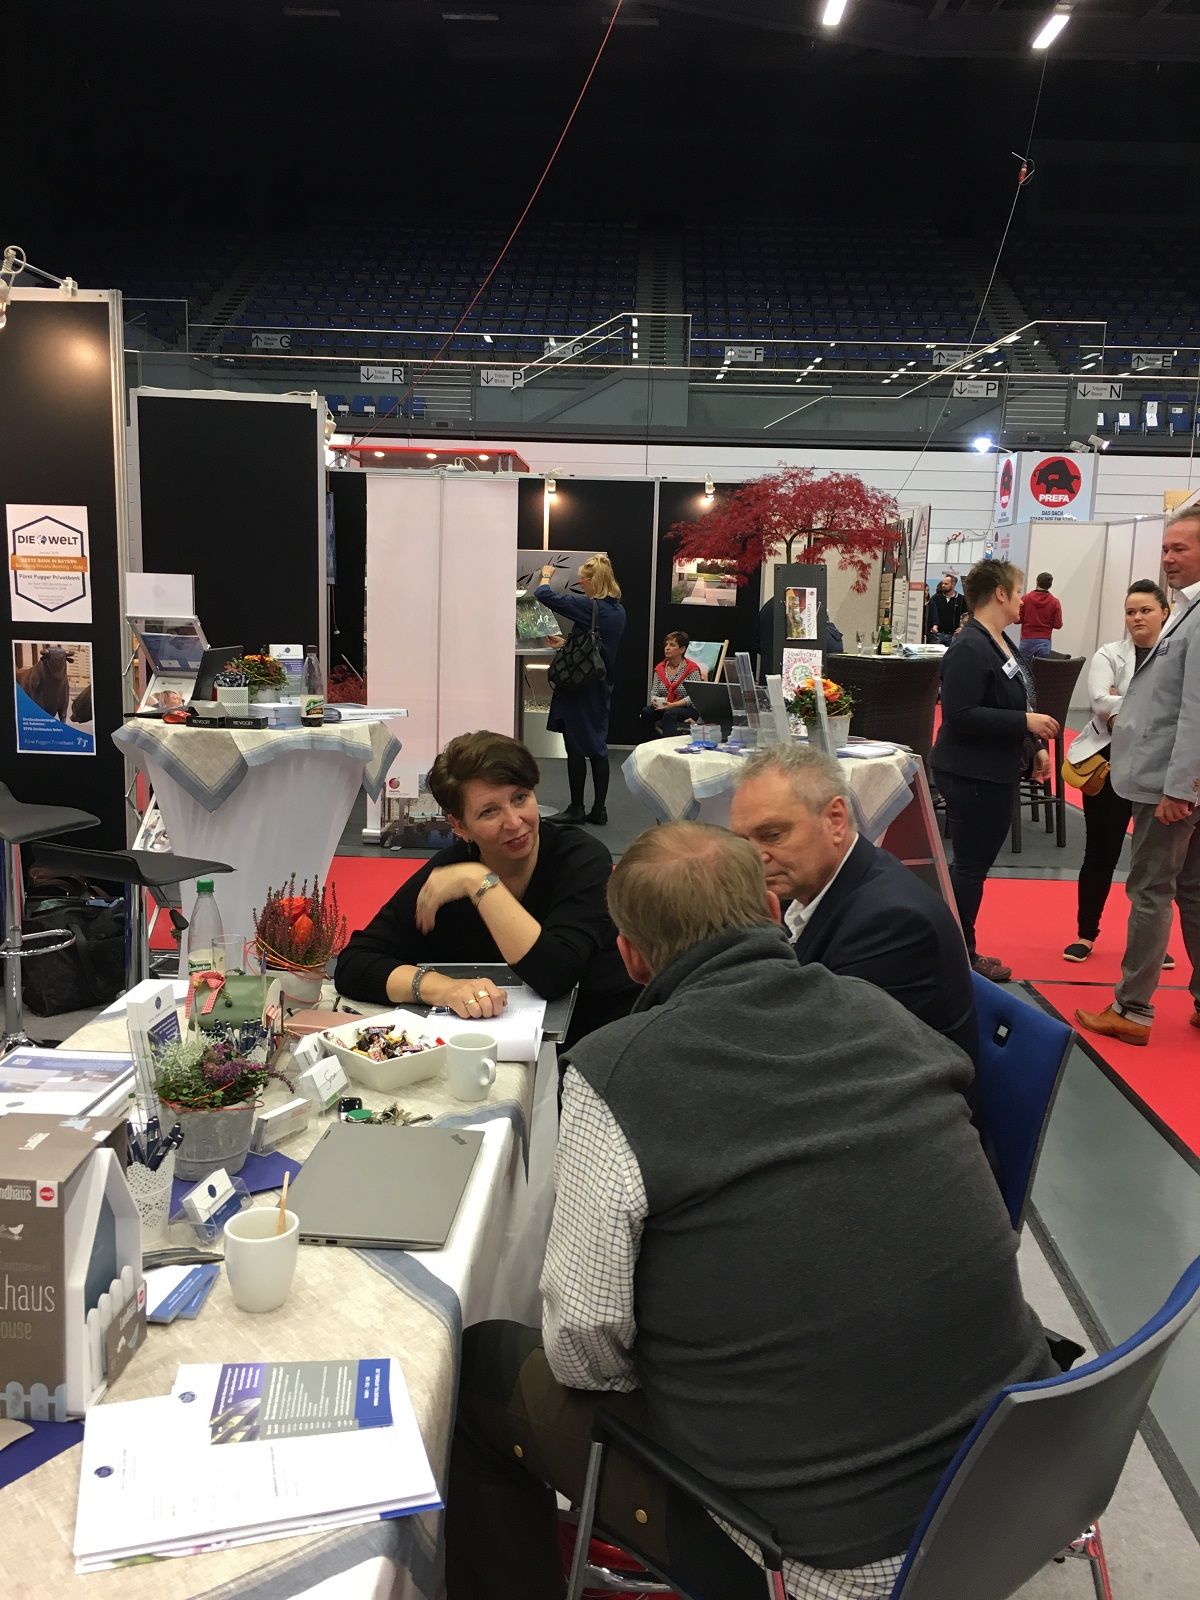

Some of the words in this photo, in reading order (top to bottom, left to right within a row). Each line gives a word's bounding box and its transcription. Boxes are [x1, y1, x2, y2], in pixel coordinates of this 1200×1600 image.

[280, 335, 291, 348] G
[754, 348, 763, 360] F
[1162, 355, 1172, 368] E
[392, 368, 404, 382] R
[512, 372, 523, 385] P
[986, 382, 997, 396] P
[1109, 385, 1122, 398] N
[1038, 494, 1070, 502] PREFA
[17, 535, 35, 544] DIE
